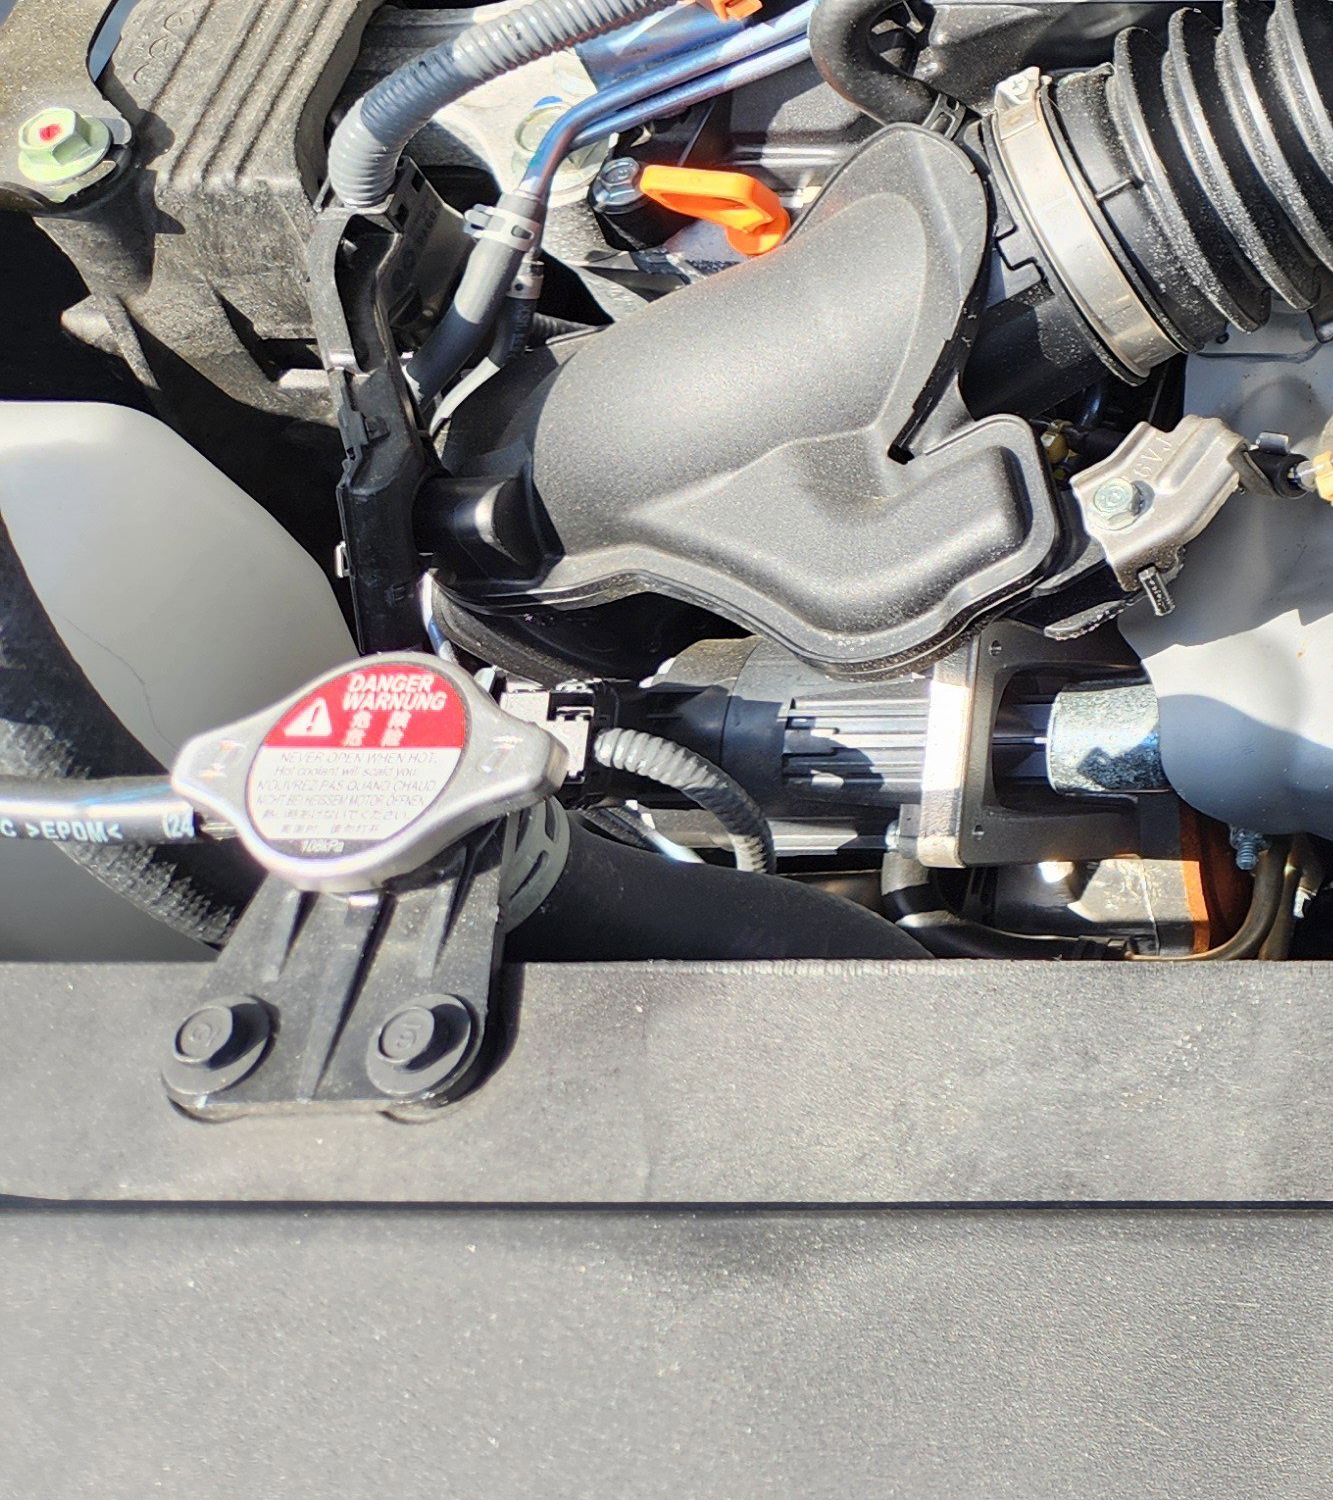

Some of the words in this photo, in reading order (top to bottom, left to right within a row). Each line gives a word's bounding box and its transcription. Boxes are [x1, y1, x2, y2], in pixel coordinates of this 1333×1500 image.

[348, 673, 435, 692] DANGER
[342, 691, 447, 711] WARNUNG
[281, 752, 322, 764] NEVER
[327, 752, 364, 764] OPEN
[367, 752, 405, 764] WHEN
[275, 766, 290, 776] Hot
[342, 766, 359, 777] will
[363, 766, 390, 777] scald
[319, 779, 344, 791] PAS
[346, 779, 390, 792] QUAND
